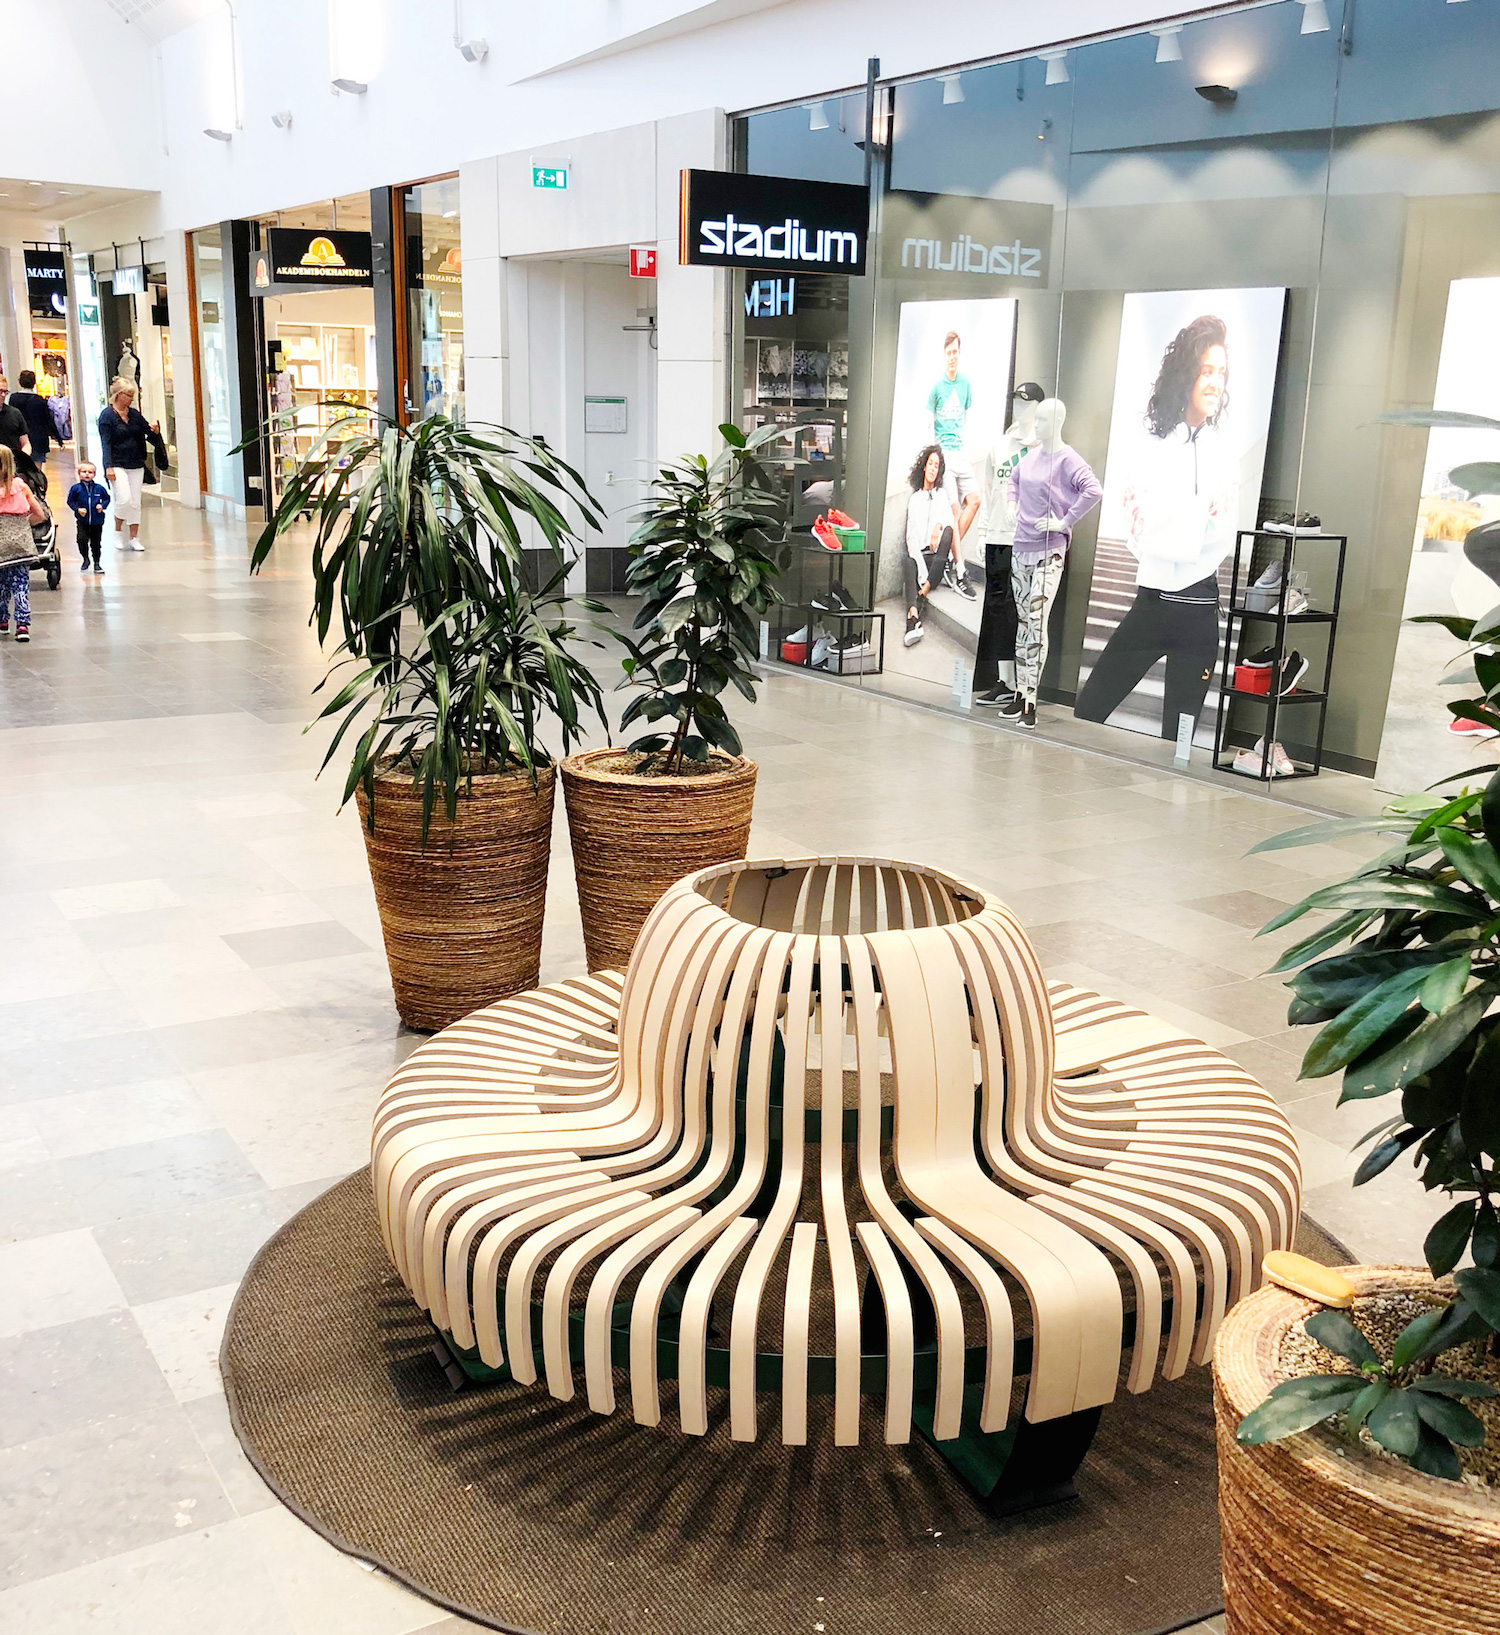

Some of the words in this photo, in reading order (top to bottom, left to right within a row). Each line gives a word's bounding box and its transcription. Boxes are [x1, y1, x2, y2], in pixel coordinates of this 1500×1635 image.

[699, 213, 858, 264] stadium
[26, 267, 65, 279] MARTY
[276, 266, 370, 277] AKADEMIBOKHANDELN
